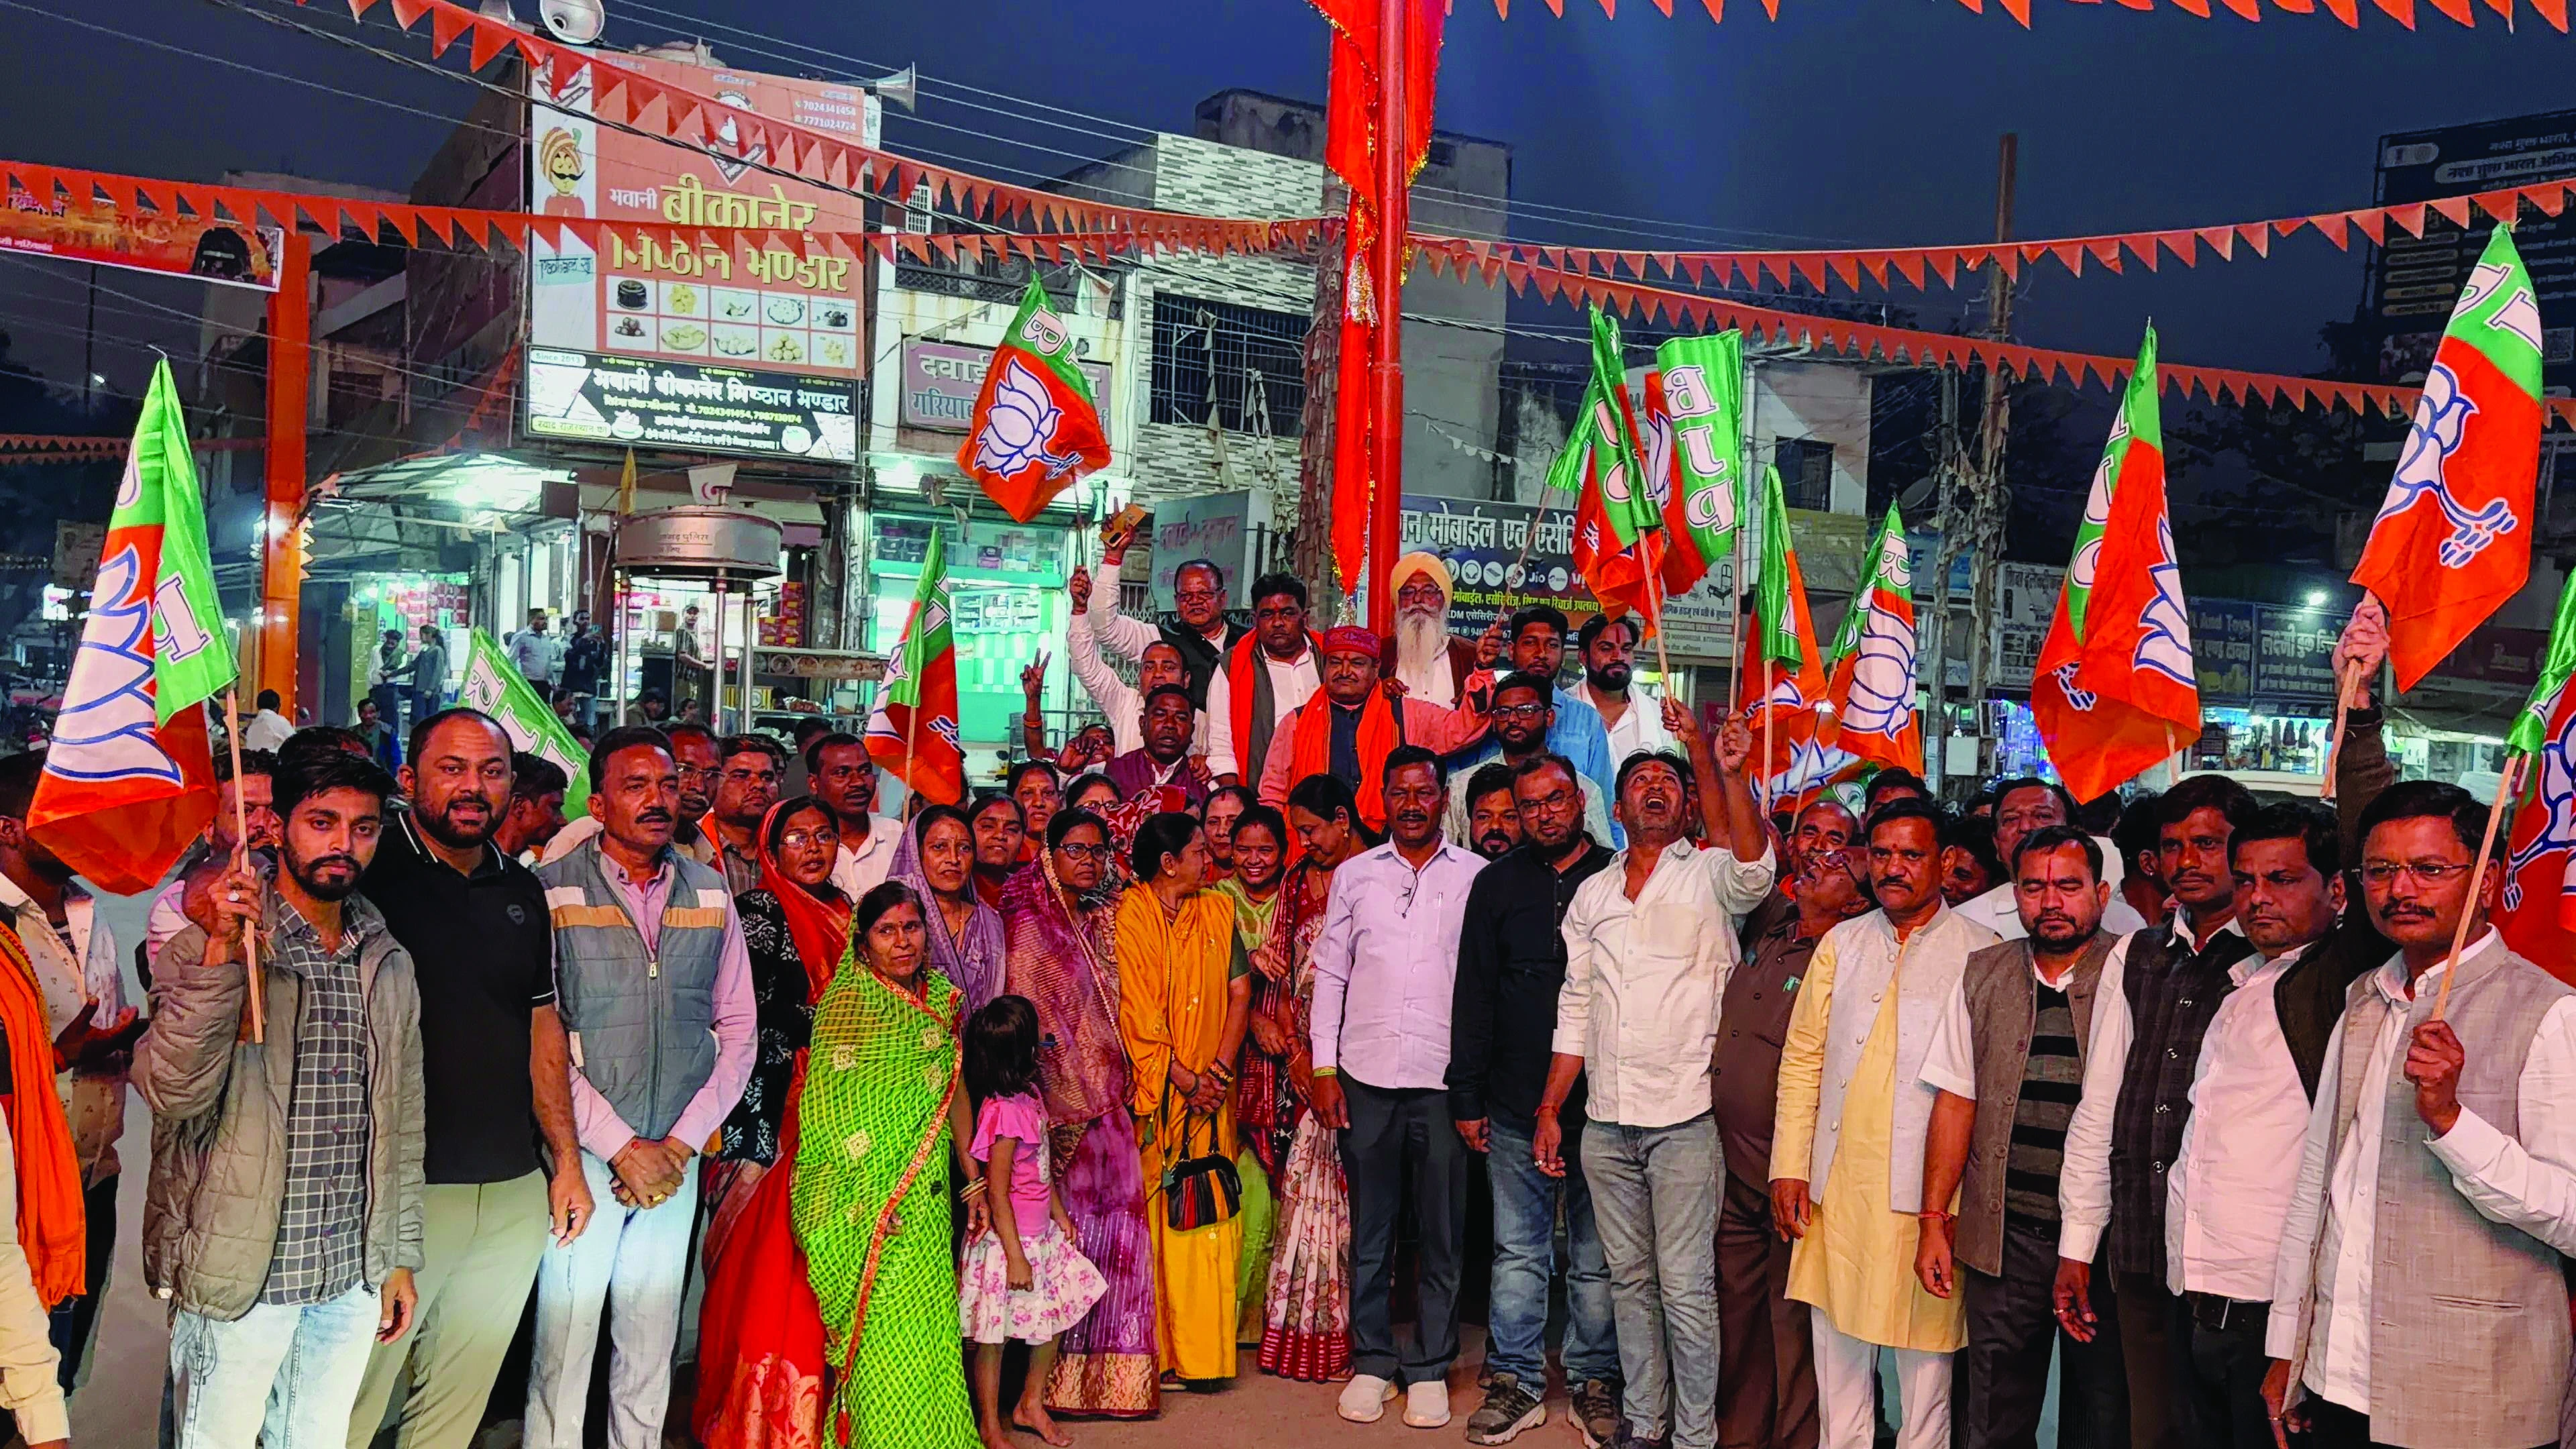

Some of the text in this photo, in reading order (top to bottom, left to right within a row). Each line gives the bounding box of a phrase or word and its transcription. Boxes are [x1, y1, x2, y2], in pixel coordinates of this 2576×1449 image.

[803, 101, 856, 116] 7024341454
[610, 172, 817, 242] भवानी बीकानेर
[535, 353, 580, 364] Since 2013
[593, 367, 850, 413] भवानी बीकानेर मिष्ठान भण्डार
[559, 421, 594, 432] राजस्थान
[1428, 501, 1497, 551] मोबाईल
[1502, 513, 1530, 550] एवं
[1528, 572, 1546, 583] Jio
[1574, 600, 1599, 612] उपलब्ध
